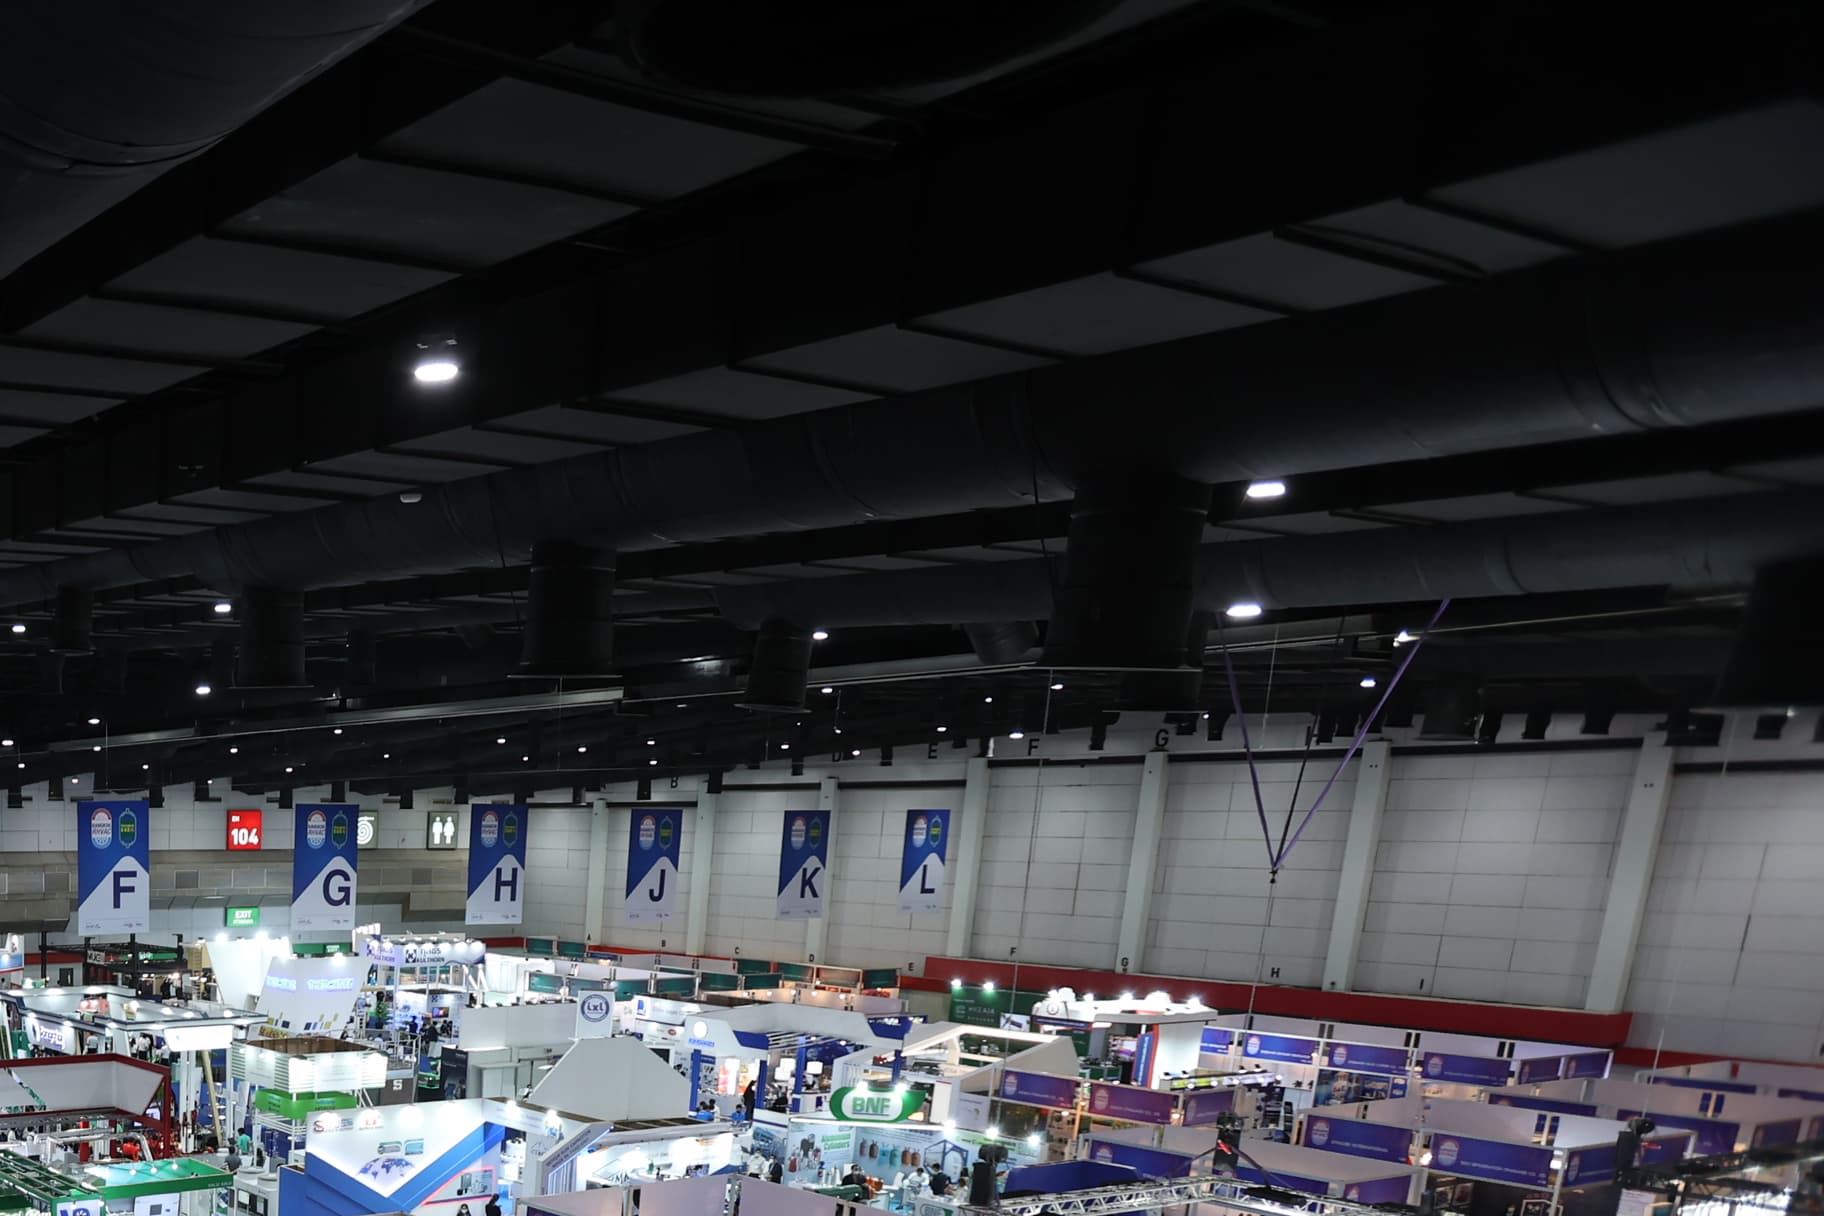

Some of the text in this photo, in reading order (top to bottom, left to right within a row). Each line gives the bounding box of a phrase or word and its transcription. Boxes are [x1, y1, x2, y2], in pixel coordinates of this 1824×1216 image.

[232, 828, 259, 845] 104
[113, 870, 137, 909] F
[323, 869, 351, 906] G
[494, 867, 518, 902] H
[649, 869, 666, 902] J
[800, 866, 821, 899] K
[920, 863, 936, 895] L
[235, 910, 253, 918] EXIT
[852, 1097, 891, 1114] BNF
